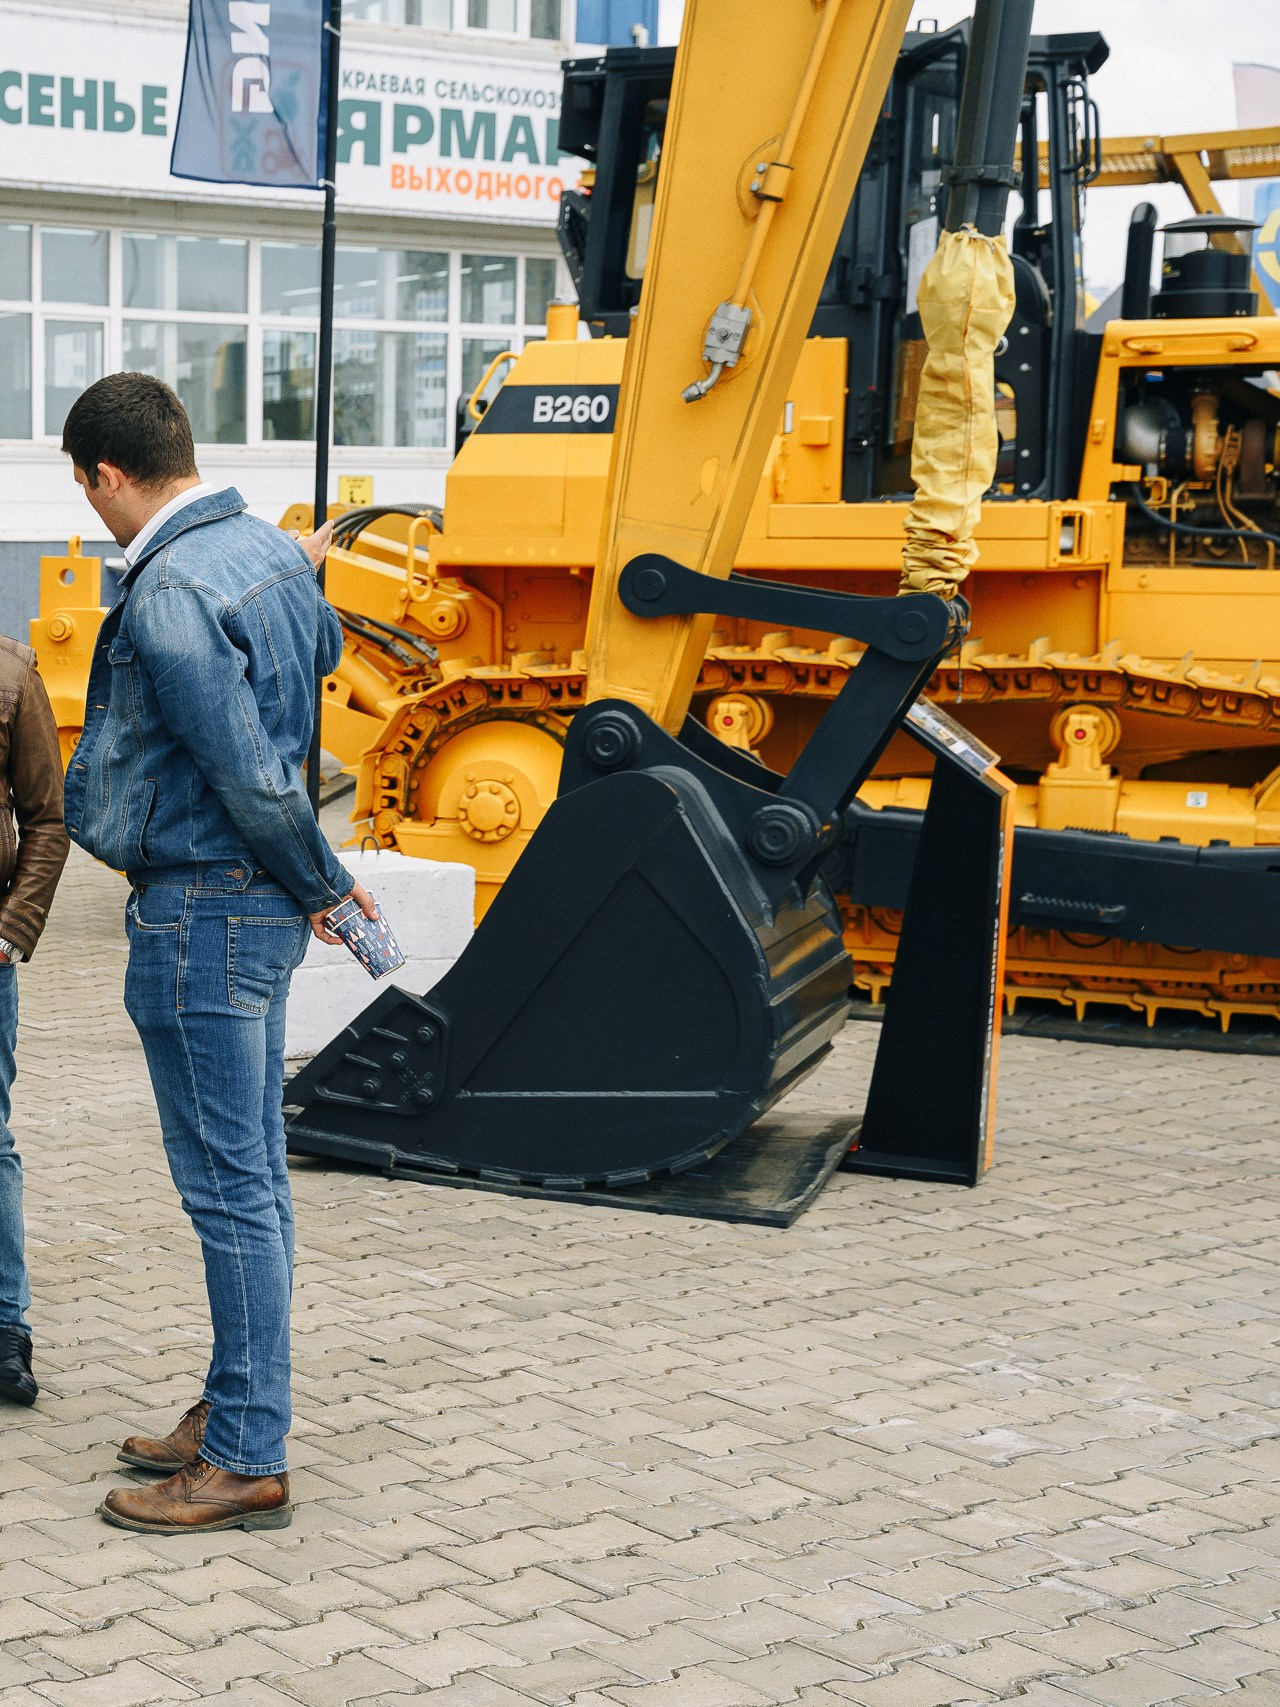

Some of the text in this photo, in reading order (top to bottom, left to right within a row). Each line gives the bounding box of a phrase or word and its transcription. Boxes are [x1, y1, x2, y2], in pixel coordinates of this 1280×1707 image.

[342, 70, 561, 109] КРАЕВАЯ СЕЛЬСКОХОЗ
[391, 163, 564, 202] ВЫХОДНОГО
[532, 394, 611, 423] B260
